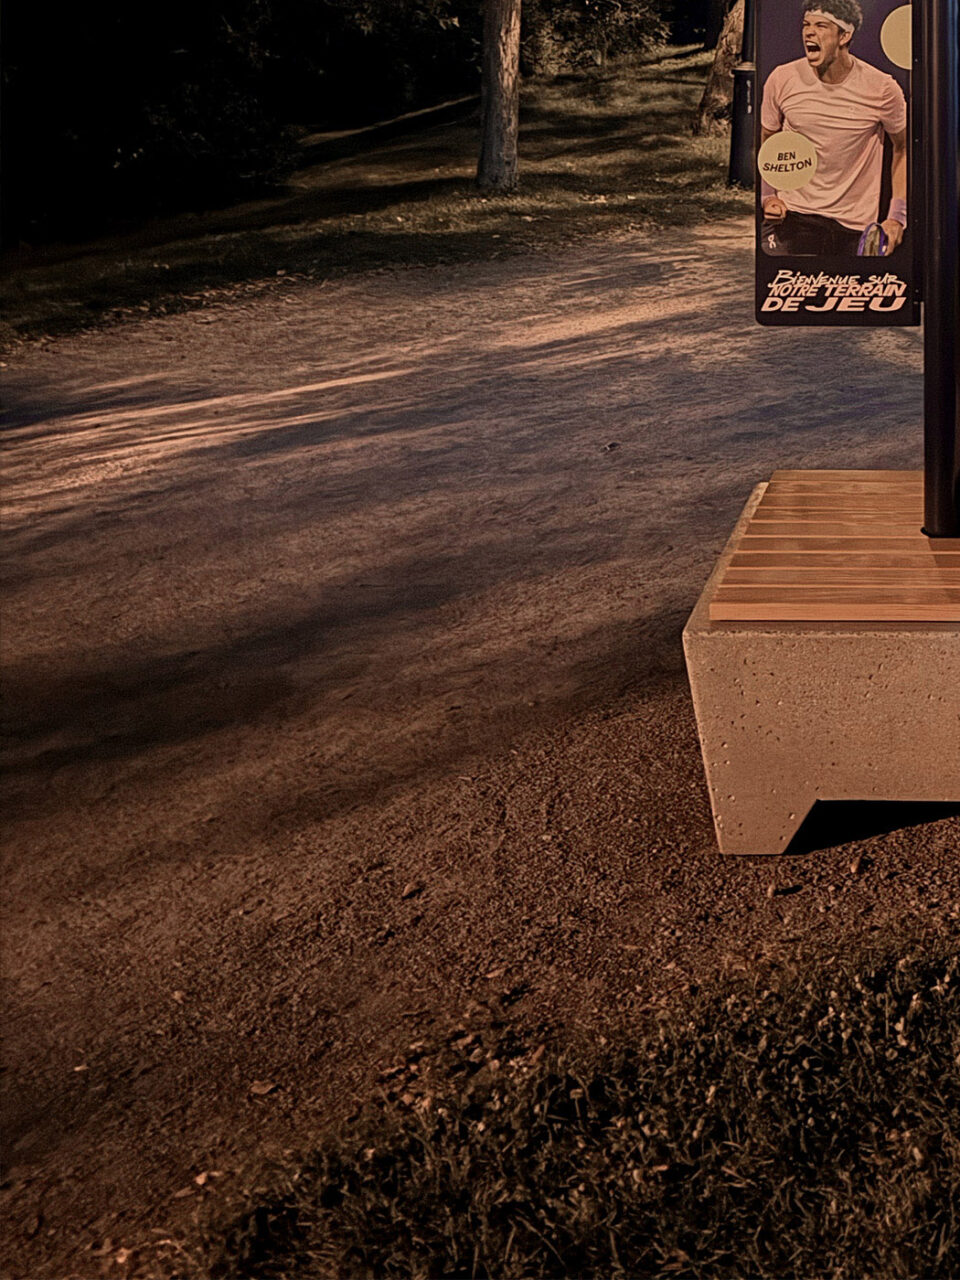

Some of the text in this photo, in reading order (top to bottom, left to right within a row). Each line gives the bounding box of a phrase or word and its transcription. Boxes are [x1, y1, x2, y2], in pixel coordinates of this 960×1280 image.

[777, 151, 796, 162] BEN
[762, 157, 812, 173] SHELTON
[767, 283, 908, 297] NOTRE TERRAIN
[760, 297, 907, 312] DE JEU
